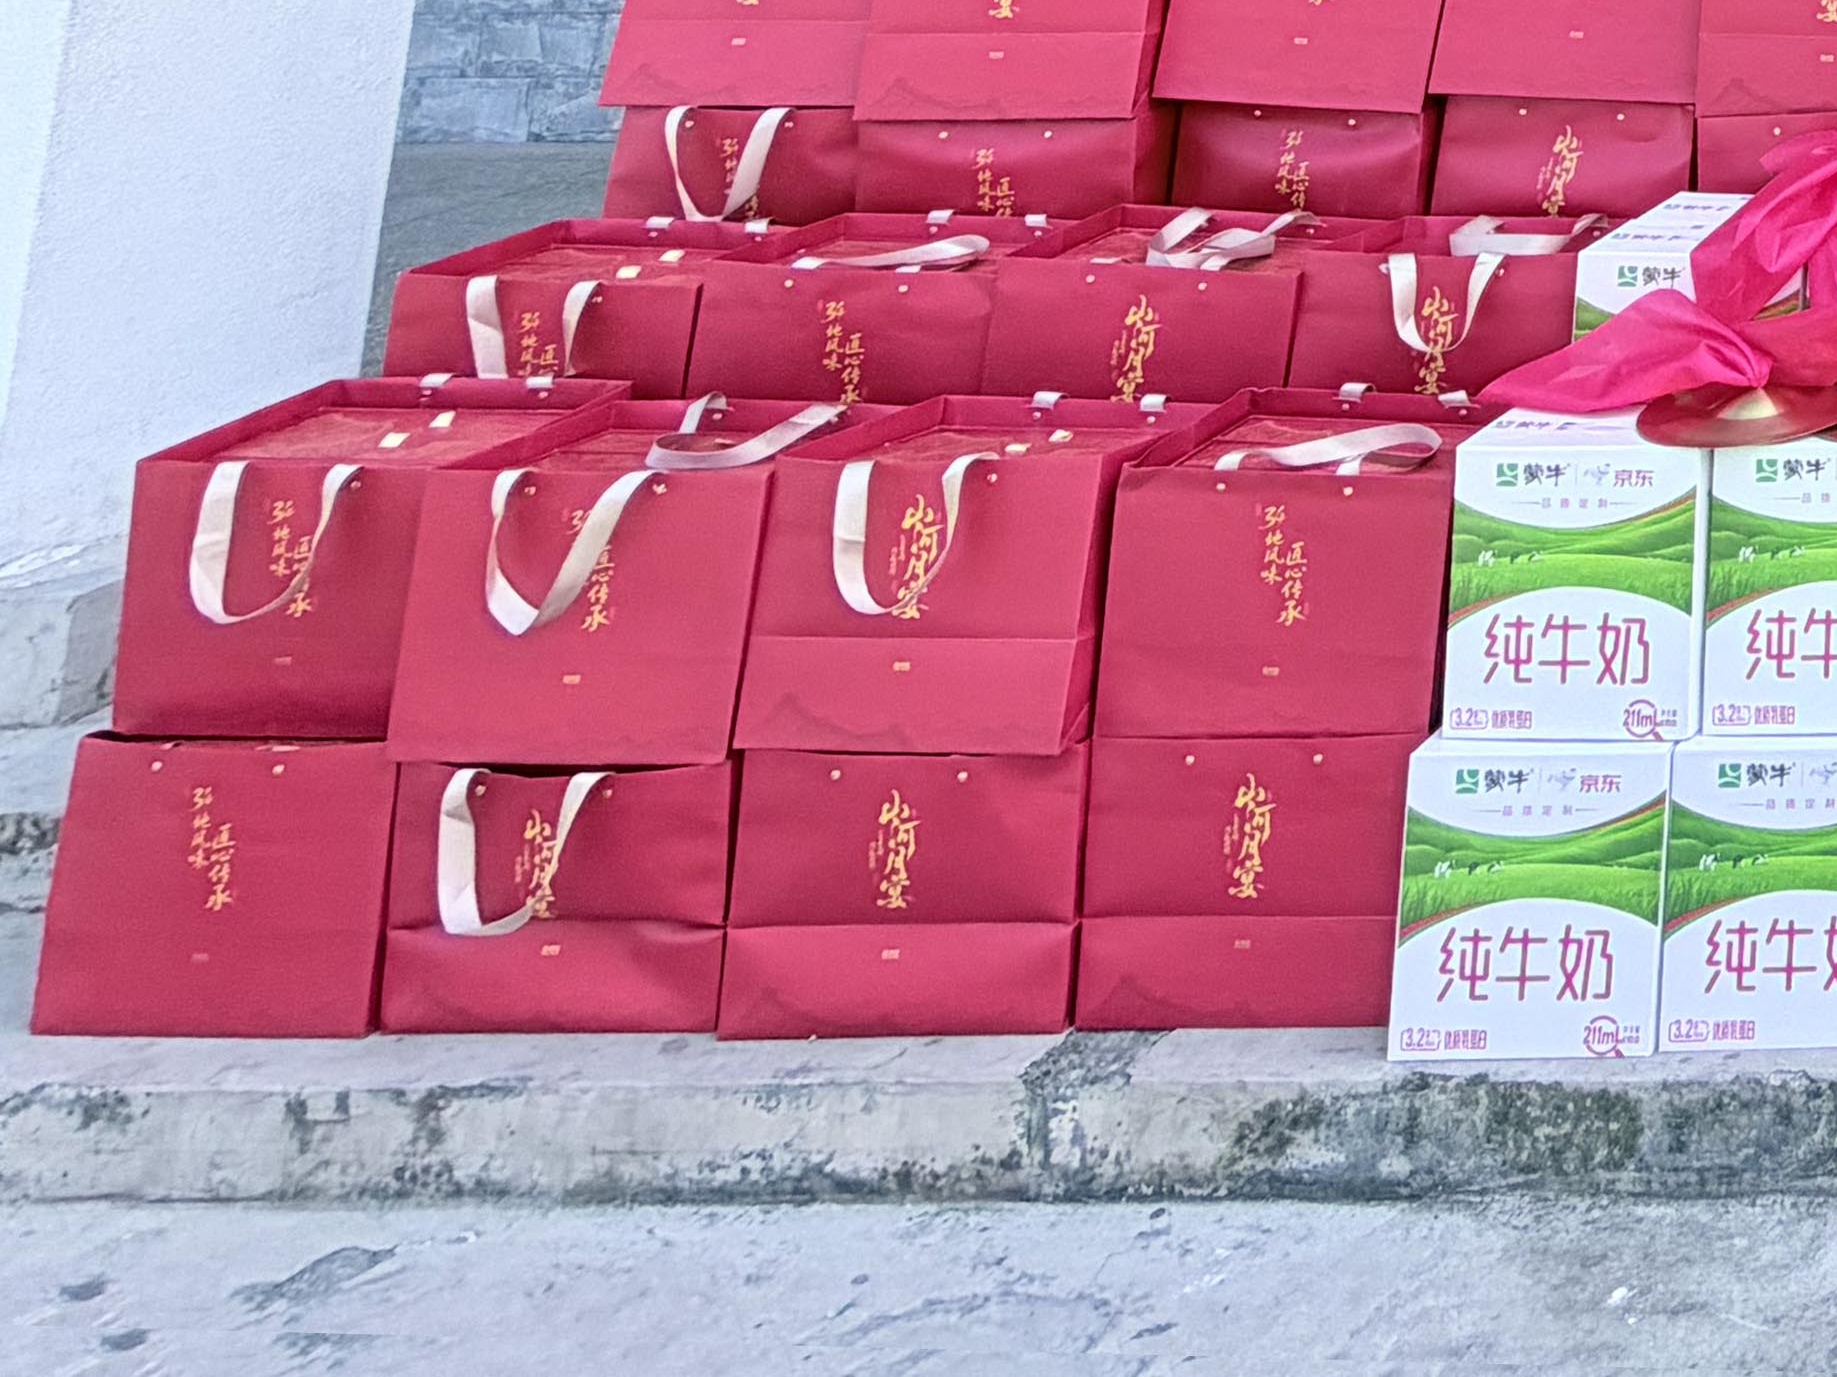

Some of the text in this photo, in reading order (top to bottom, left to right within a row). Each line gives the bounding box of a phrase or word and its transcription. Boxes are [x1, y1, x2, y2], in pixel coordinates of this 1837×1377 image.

[1641, 266, 1681, 287] 蒙牛
[1523, 462, 1653, 487] 蒙牛 京东
[1782, 457, 1827, 481] 蒙牛
[1484, 611, 1650, 685] 纯牛奶
[1484, 768, 1620, 793] 蒙牛 京东
[1746, 762, 1792, 787] 蒙牛
[1438, 924, 1614, 1002] 纯牛奶
